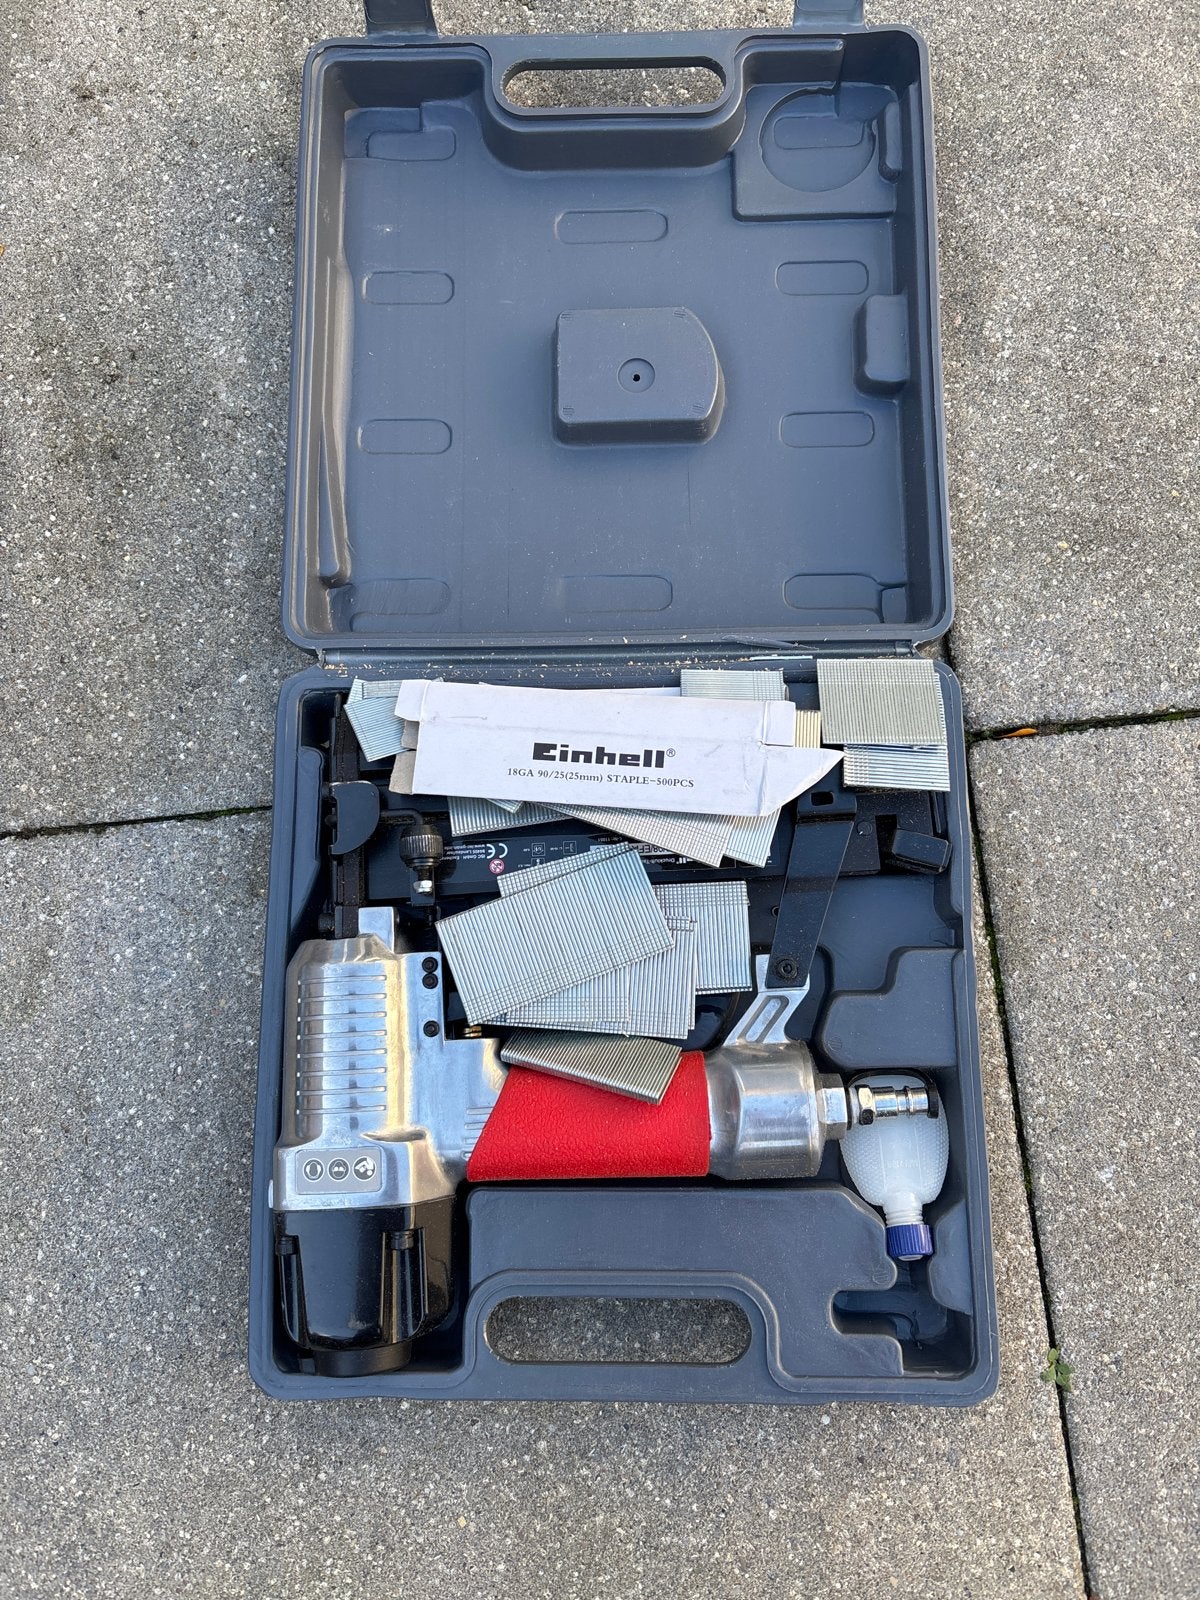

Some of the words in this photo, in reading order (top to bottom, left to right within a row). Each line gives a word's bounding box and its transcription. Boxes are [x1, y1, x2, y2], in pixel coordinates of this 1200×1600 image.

[507, 768, 534, 777] 18GA
[537, 769, 603, 783] 90/25(25mm)
[606, 774, 695, 788] STAPLE-500PCS
